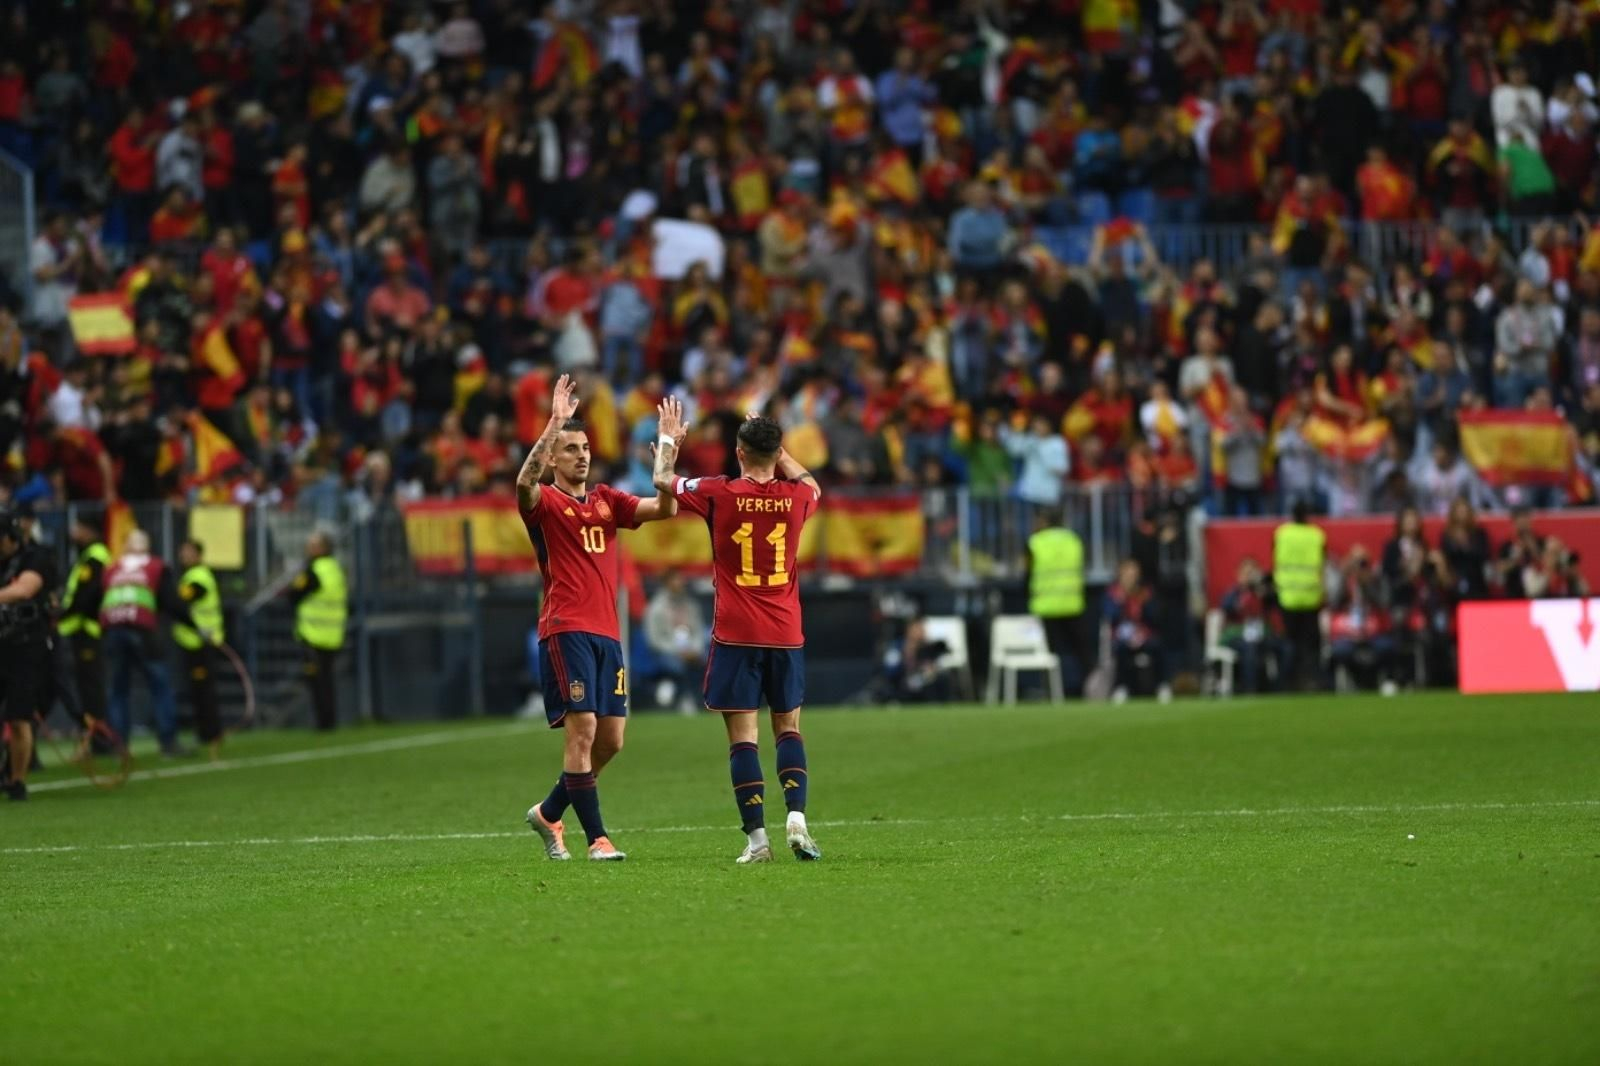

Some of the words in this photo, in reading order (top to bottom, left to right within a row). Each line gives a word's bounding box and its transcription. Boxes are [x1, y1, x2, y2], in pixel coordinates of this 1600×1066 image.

[736, 497, 792, 512] YEREMY
[580, 526, 606, 553] 10
[731, 523, 789, 586] 11
[614, 667, 627, 696] 1
